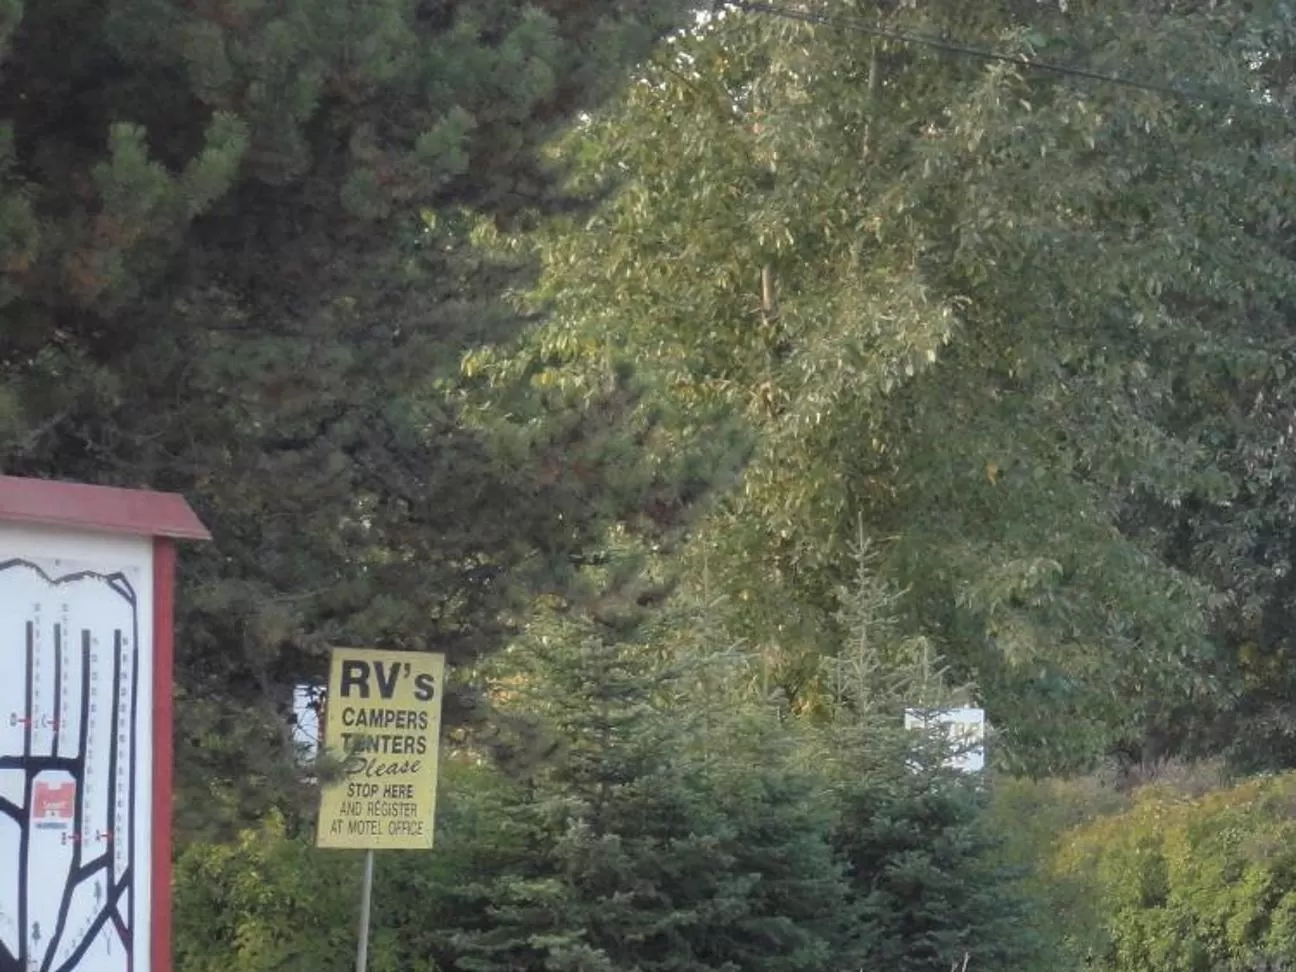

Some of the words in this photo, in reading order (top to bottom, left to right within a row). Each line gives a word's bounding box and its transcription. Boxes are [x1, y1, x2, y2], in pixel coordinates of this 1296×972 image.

[340, 660, 434, 701] RV's
[342, 706, 428, 730] CAMPERS
[342, 756, 421, 777] Please
[347, 782, 379, 798] STOP
[383, 783, 414, 799] HERE
[340, 800, 362, 817] AND
[367, 801, 418, 818] REGISTER
[330, 819, 343, 836] AT
[348, 820, 382, 836] MOTEL
[388, 821, 424, 836] OFFICE
